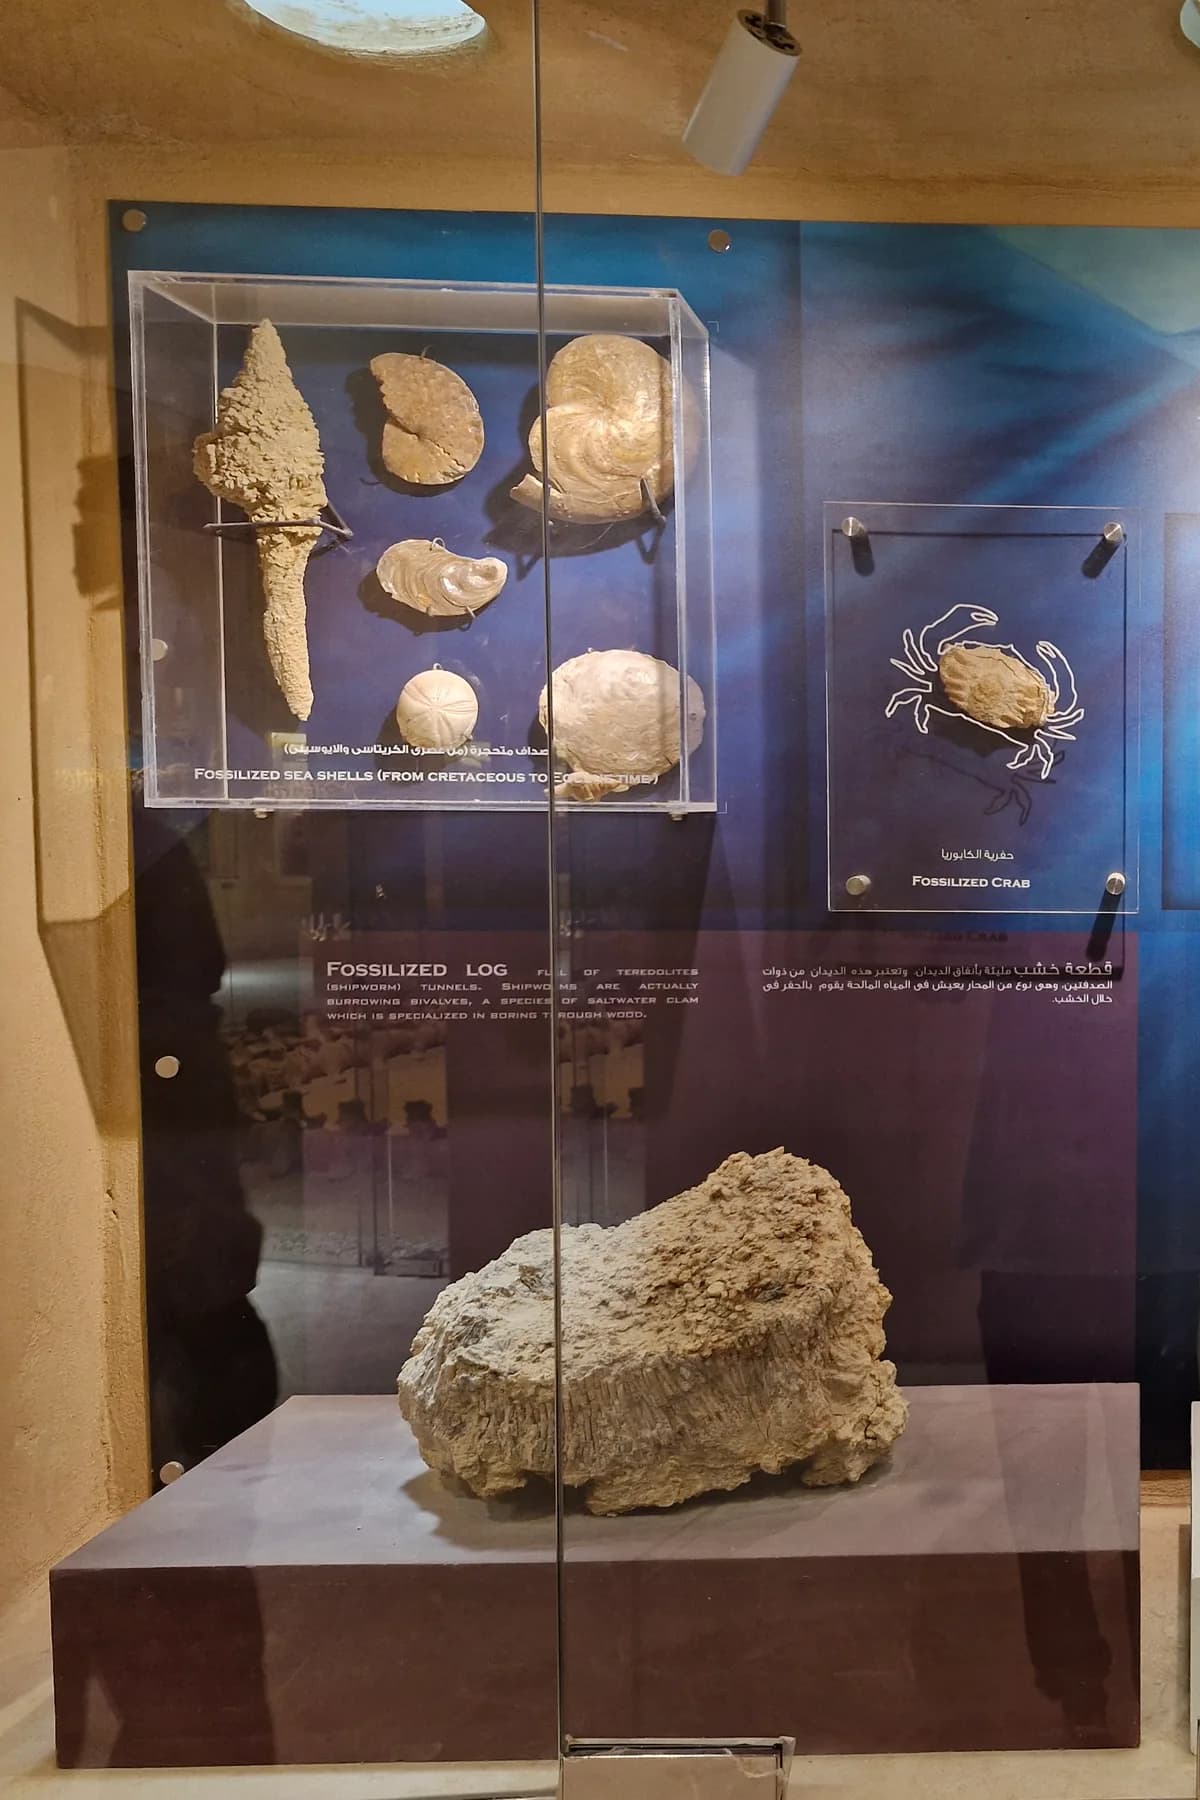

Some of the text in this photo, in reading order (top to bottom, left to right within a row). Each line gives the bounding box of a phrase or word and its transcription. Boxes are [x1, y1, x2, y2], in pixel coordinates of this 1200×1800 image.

[194, 767, 281, 781] FOSSILIZED
[284, 770, 313, 781] SEA
[317, 770, 373, 782] SHELLS
[377, 769, 424, 783] (FROM
[428, 771, 526, 783] CRETACEOUS
[529, 772, 548, 783] TO
[941, 848, 1014, 862] حفرية الكابوريا
[912, 875, 1031, 889] FOSSILIZED CRAB
[327, 961, 448, 977] FOSSILIZED
[466, 962, 508, 977] LOG
[584, 968, 600, 976] OF
[762, 966, 787, 978] ذوات
[789, 967, 805, 978] من
[810, 965, 846, 978] الديدان
[1014, 961, 1060, 978] خشب
[1065, 960, 1113, 976] قطعة
[327, 983, 401, 992] (SHIPWORM)
[420, 983, 482, 991] TUNNELS.
[781, 979, 813, 992] بالحفر
[818, 981, 844, 992] يقوم
[847, 979, 881, 991] المالحة
[883, 979, 910, 991] المياه
[931, 980, 964, 992] يعيش
[966, 979, 994, 992] المحار
[997, 981, 1012, 992] من
[1015, 980, 1032, 992] نوع
[1035, 981, 1058, 992] وهى
[327, 998, 401, 1006] BURROWING
[411, 998, 472, 1007] BIVALVES,
[501, 997, 552, 1006] SPECIES
[562, 997, 577, 1005] OF
[588, 997, 657, 1005] SALTWATER
[666, 996, 699, 1004] CLAM
[327, 1012, 366, 1020] WHICH
[372, 1012, 384, 1020] IS
[389, 1012, 468, 1020] SPECIALIZED
[606, 1011, 647, 1019] WOOD.
